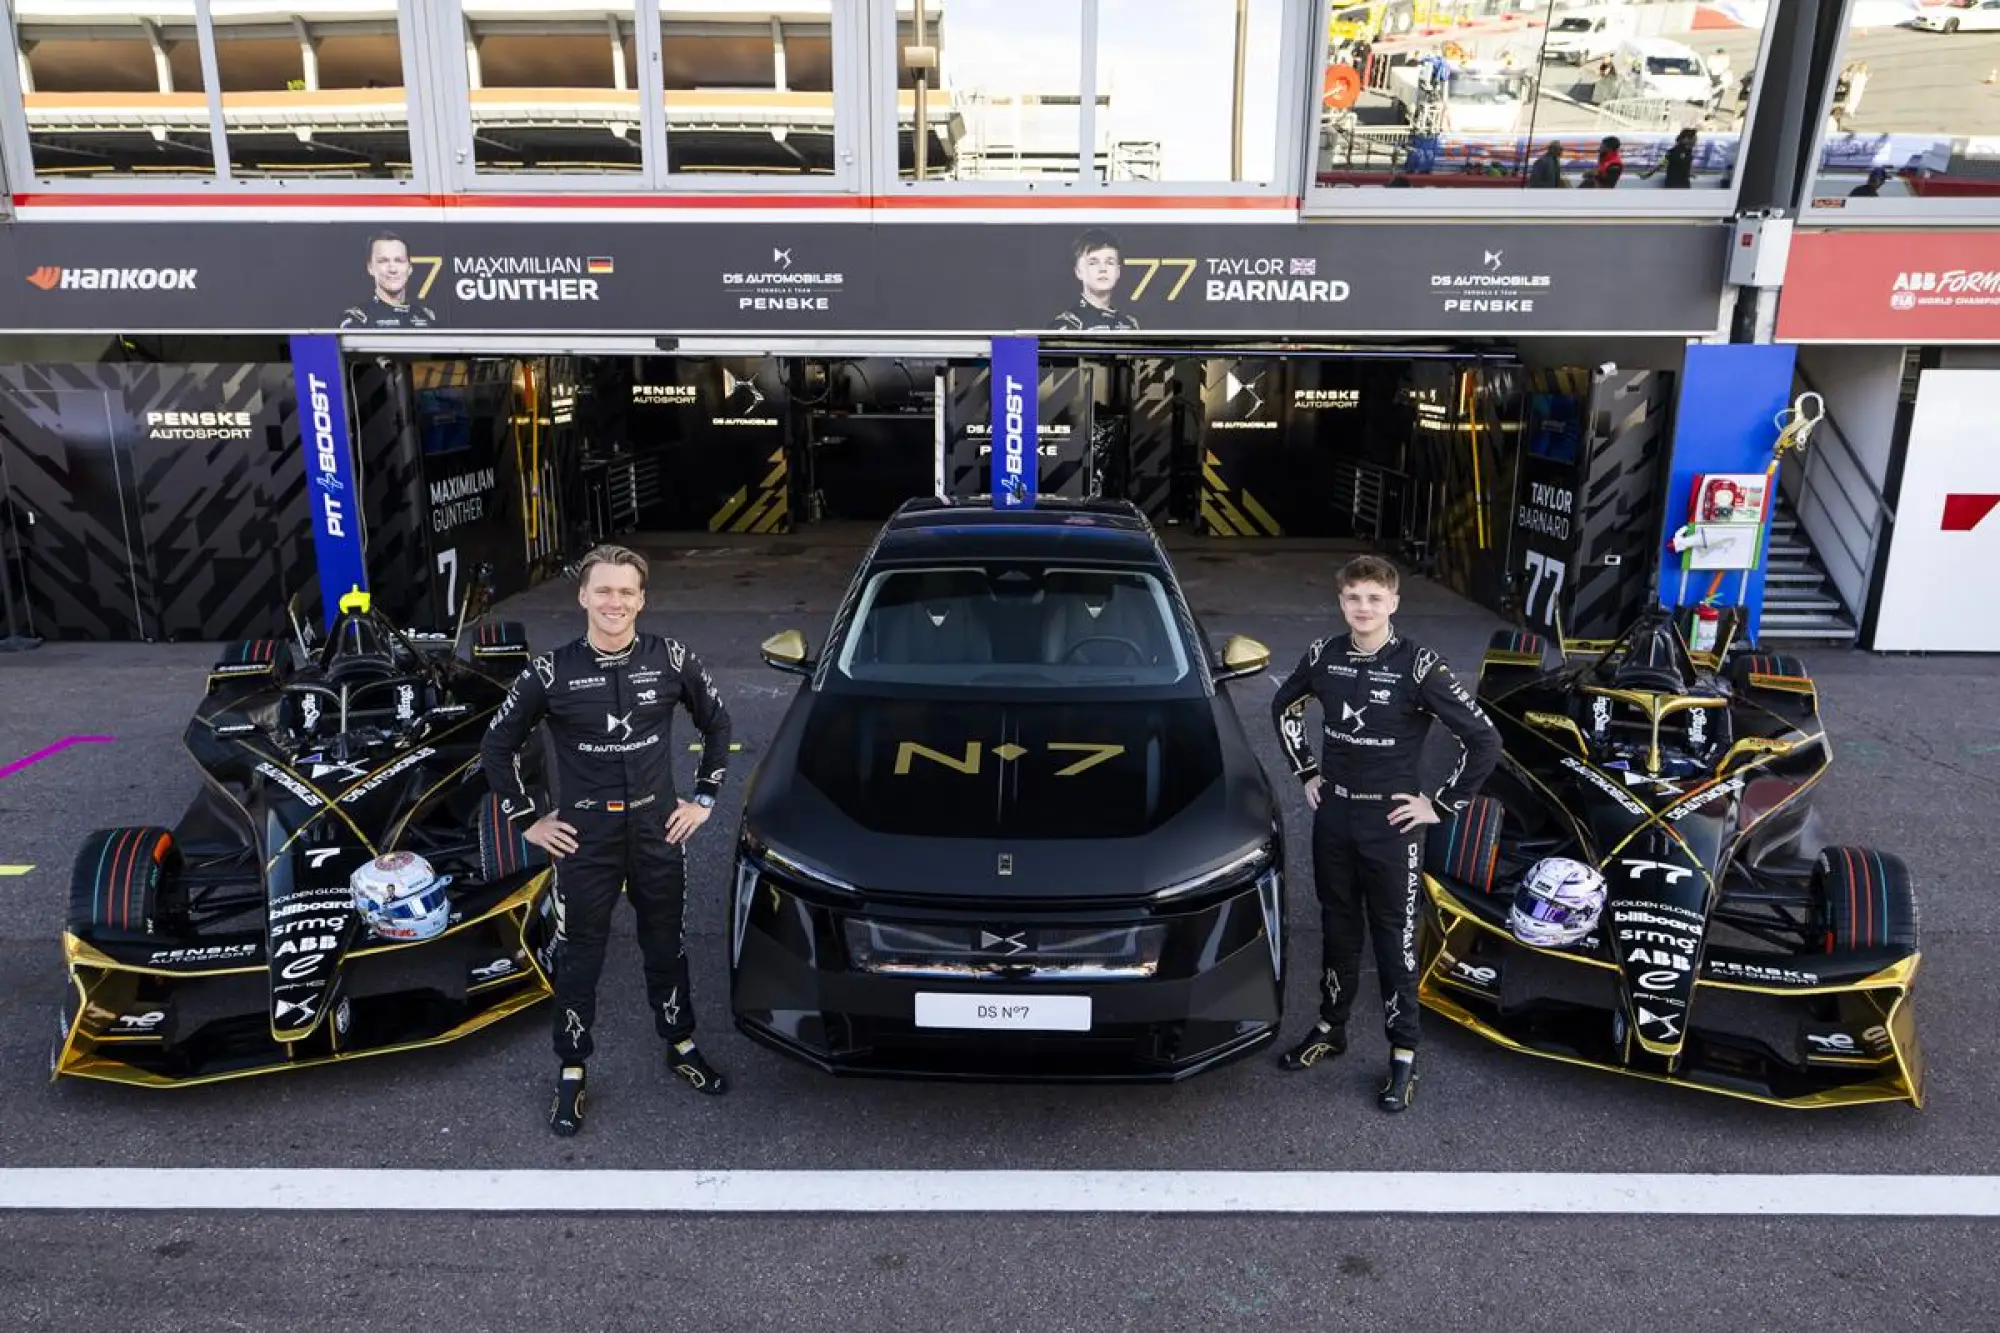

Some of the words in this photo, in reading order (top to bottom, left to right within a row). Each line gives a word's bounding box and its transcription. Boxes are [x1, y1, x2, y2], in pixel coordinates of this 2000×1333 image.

[453, 257, 581, 274] MAXIMILIAN
[1206, 258, 1284, 276] TAYLOR
[410, 256, 443, 300] 7
[455, 272, 599, 301] GÜNTHER
[722, 273, 743, 284] DS
[745, 273, 844, 284] AUTOMOBILES
[1124, 258, 1197, 301] 77
[1431, 275, 1451, 286] DS
[1453, 275, 1551, 286] AUTOMOBILES
[1892, 272, 1936, 291] ABB
[1206, 280, 1350, 302] BARNARD
[739, 297, 829, 310] PENSKE
[1444, 299, 1534, 312] PENSKE
[632, 385, 696, 396] PENSKE
[1295, 390, 1360, 400] PENSKE
[147, 412, 251, 426] PENSKE
[308, 373, 337, 474] BOOST
[1006, 375, 1023, 475] BOOST
[149, 428, 252, 439] AUTOSPORT
[430, 467, 496, 505] MAXIMILIAN
[1531, 482, 1573, 511] TAYLOR
[323, 493, 345, 538] PIT
[432, 496, 484, 532] GÜNTHER
[1519, 505, 1569, 541] BARNARD
[437, 548, 458, 616] 7
[1525, 550, 1566, 626] 77
[305, 848, 340, 868] 7
[1621, 859, 1693, 884] 77
[270, 900, 355, 920] billboard
[1612, 899, 1657, 909] GOLDEN
[1614, 910, 1703, 936] billboard
[275, 935, 338, 958] ABB
[1619, 929, 1698, 954] srmg
[1627, 948, 1691, 971] ABB
[977, 1005, 998, 1018] DS
